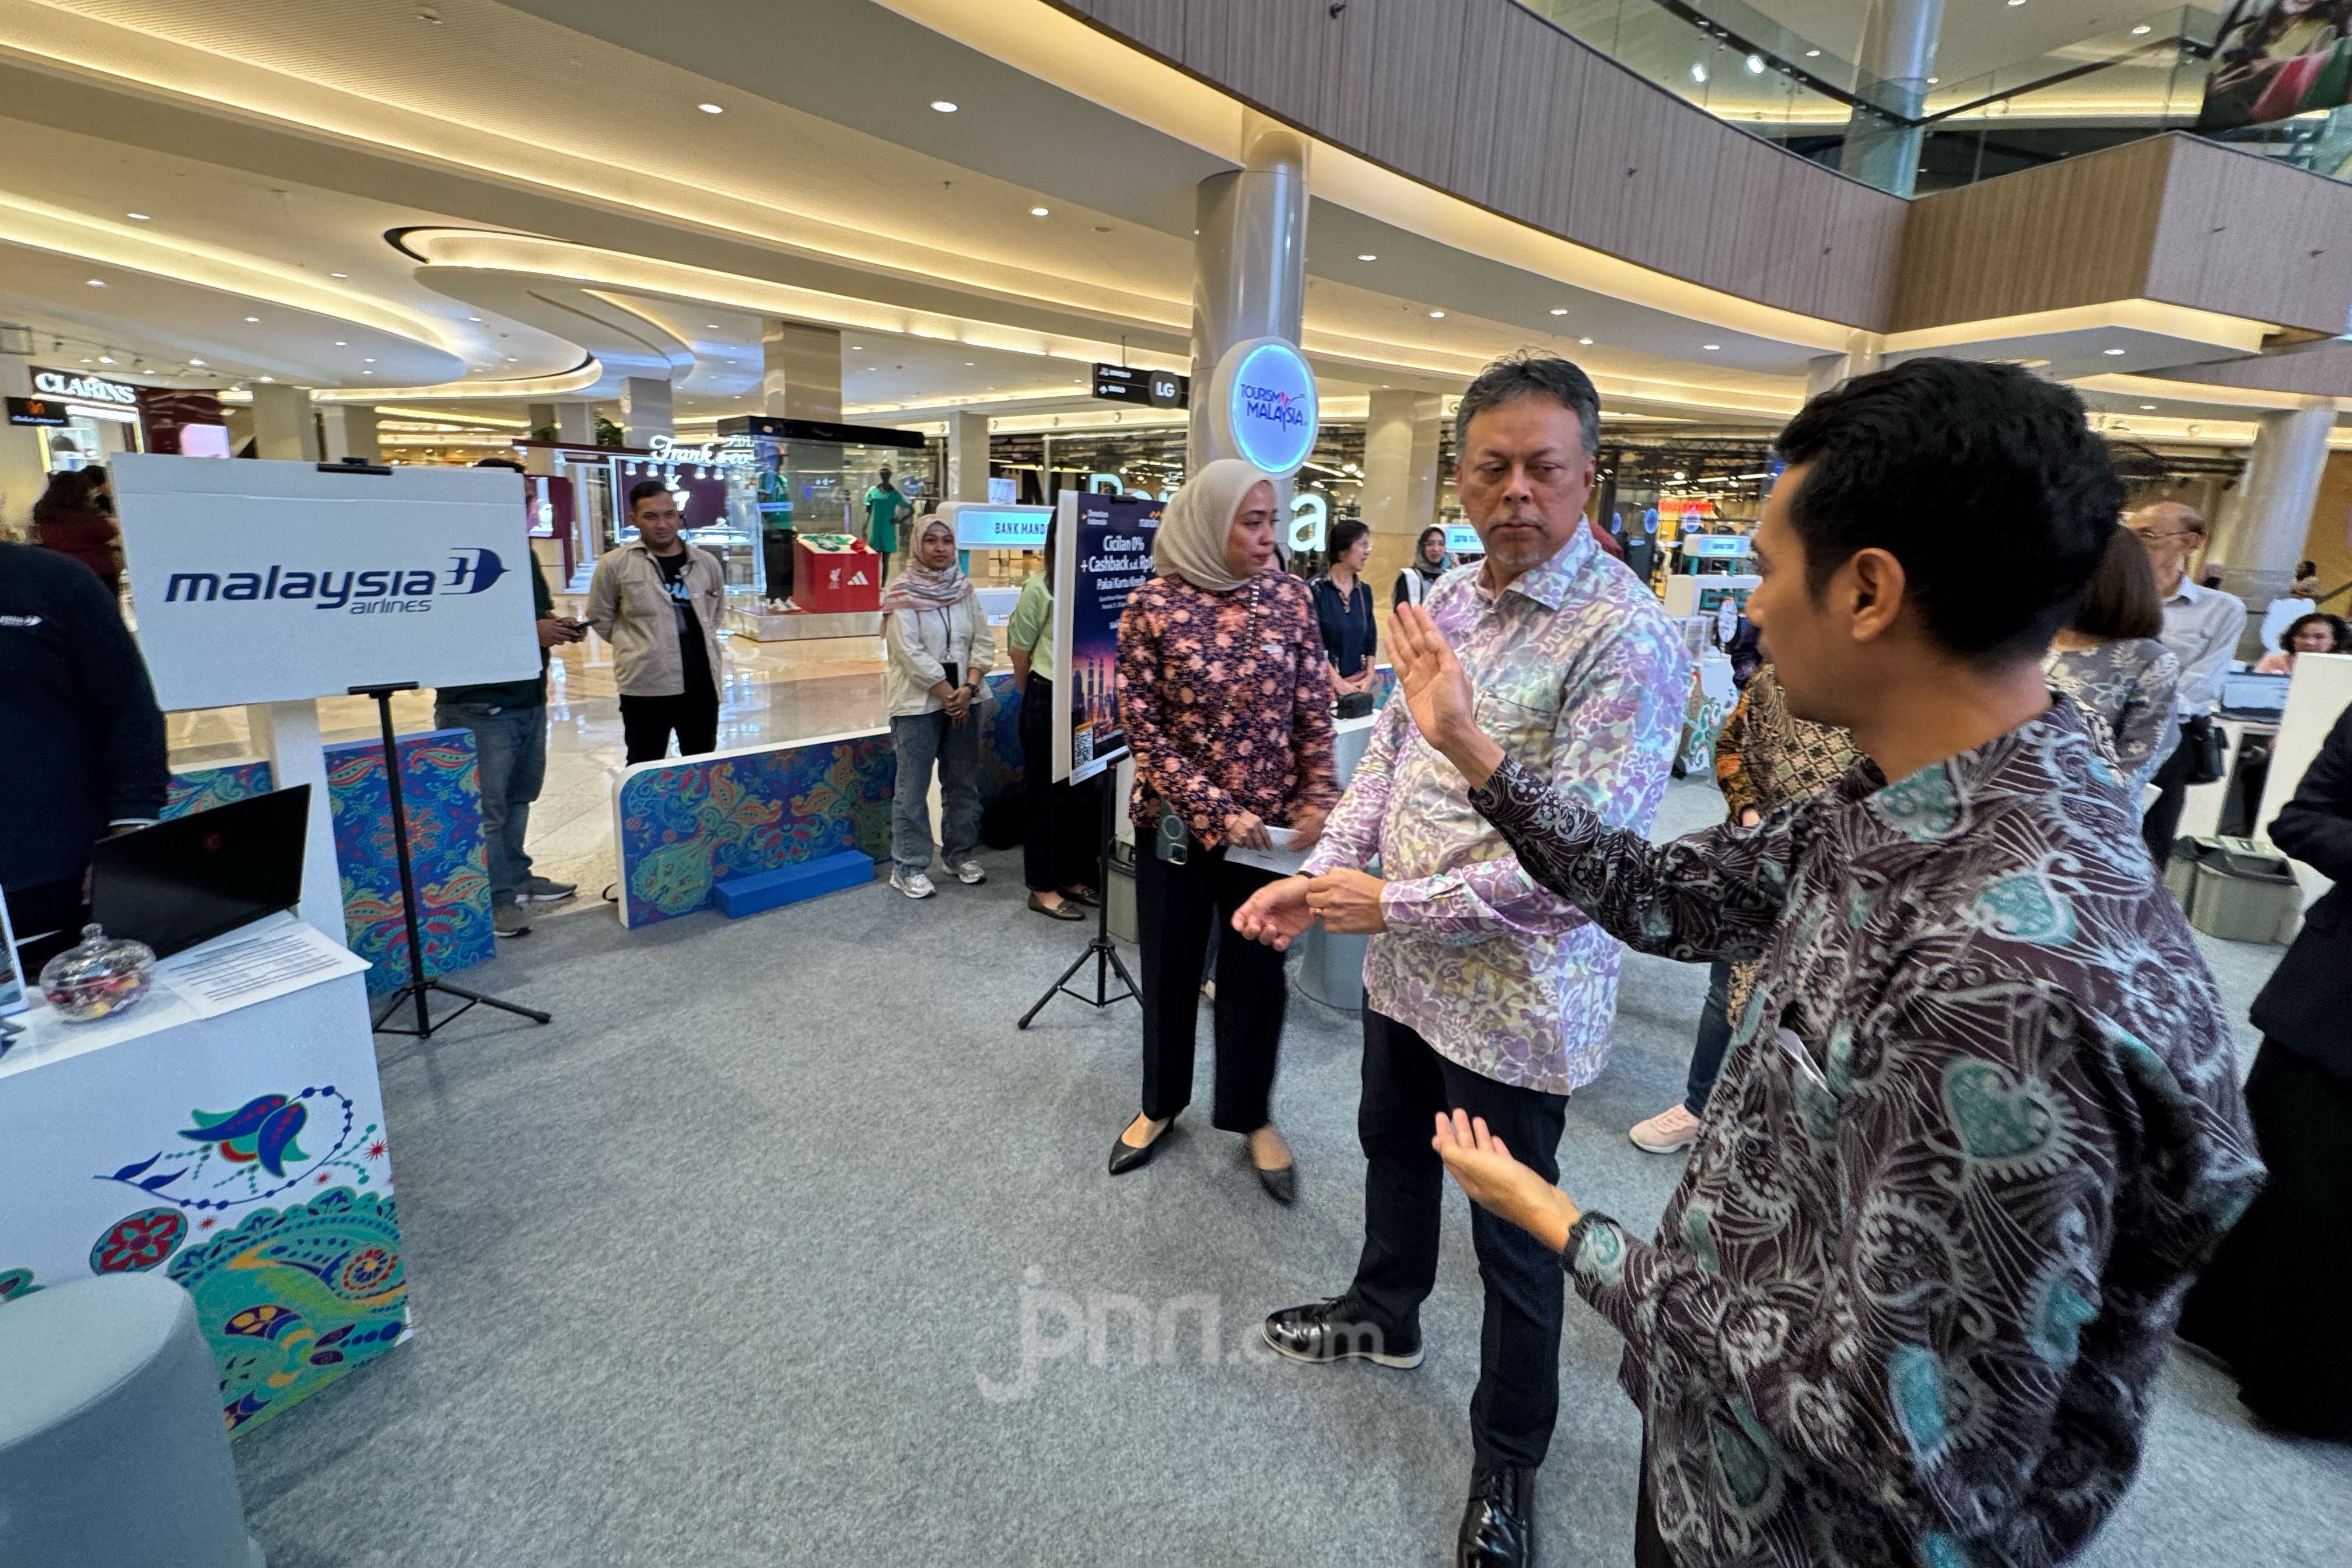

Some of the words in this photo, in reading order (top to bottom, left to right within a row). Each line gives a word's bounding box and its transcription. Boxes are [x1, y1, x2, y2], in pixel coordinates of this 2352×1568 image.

[35, 373, 136, 404] CLARINS
[1155, 382, 1175, 397] LG
[1241, 384, 1282, 404] TOURISM
[1247, 400, 1303, 432] MALAYSIA
[649, 435, 715, 464] Frank
[995, 522, 1019, 534] BANK
[1021, 523, 1045, 535] MAND
[1102, 535, 1130, 552] Cicilan
[1131, 536, 1145, 551] 0%
[165, 565, 437, 610] malaysia
[350, 598, 433, 615] airlines
